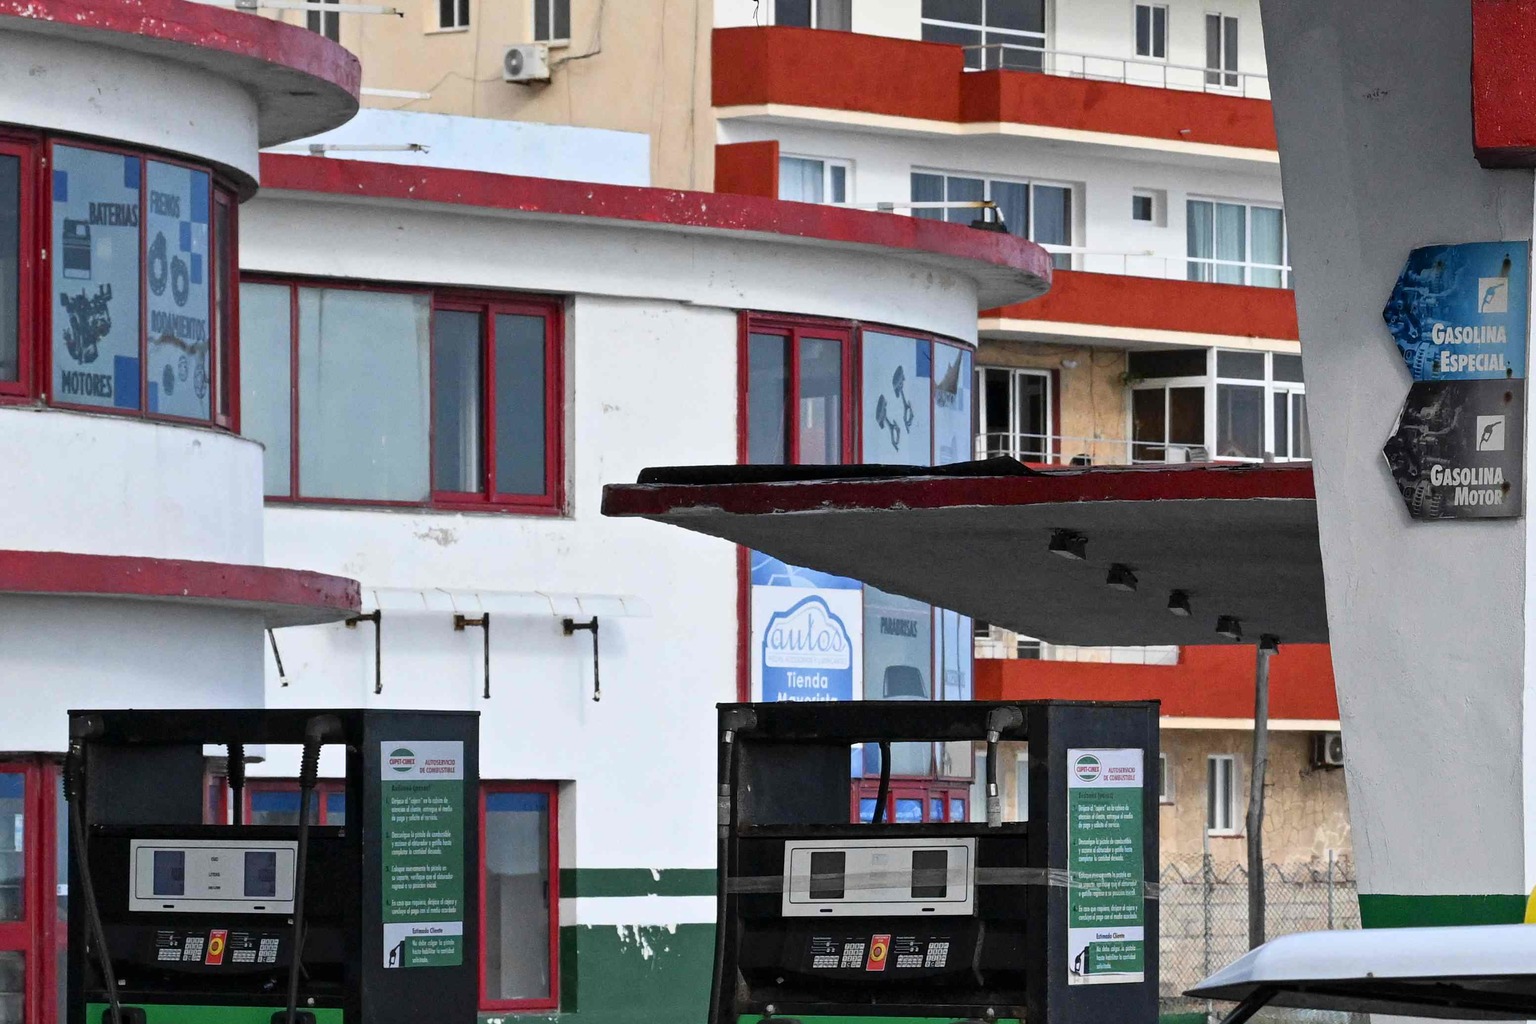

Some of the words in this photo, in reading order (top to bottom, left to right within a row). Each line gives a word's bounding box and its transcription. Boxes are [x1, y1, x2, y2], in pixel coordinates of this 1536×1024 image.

[89, 202, 138, 227] BATERIAS
[151, 190, 180, 219] FRENOS
[151, 310, 205, 341] RODAMIENTOS
[1432, 323, 1506, 345] GASOLINA
[1441, 351, 1506, 372] ESPECIAL
[62, 370, 112, 398] MOTORES
[1431, 464, 1503, 486] GASOLINA
[1454, 486, 1503, 506] MOTOR
[770, 613, 847, 652] autos
[787, 672, 828, 688] Tienda
